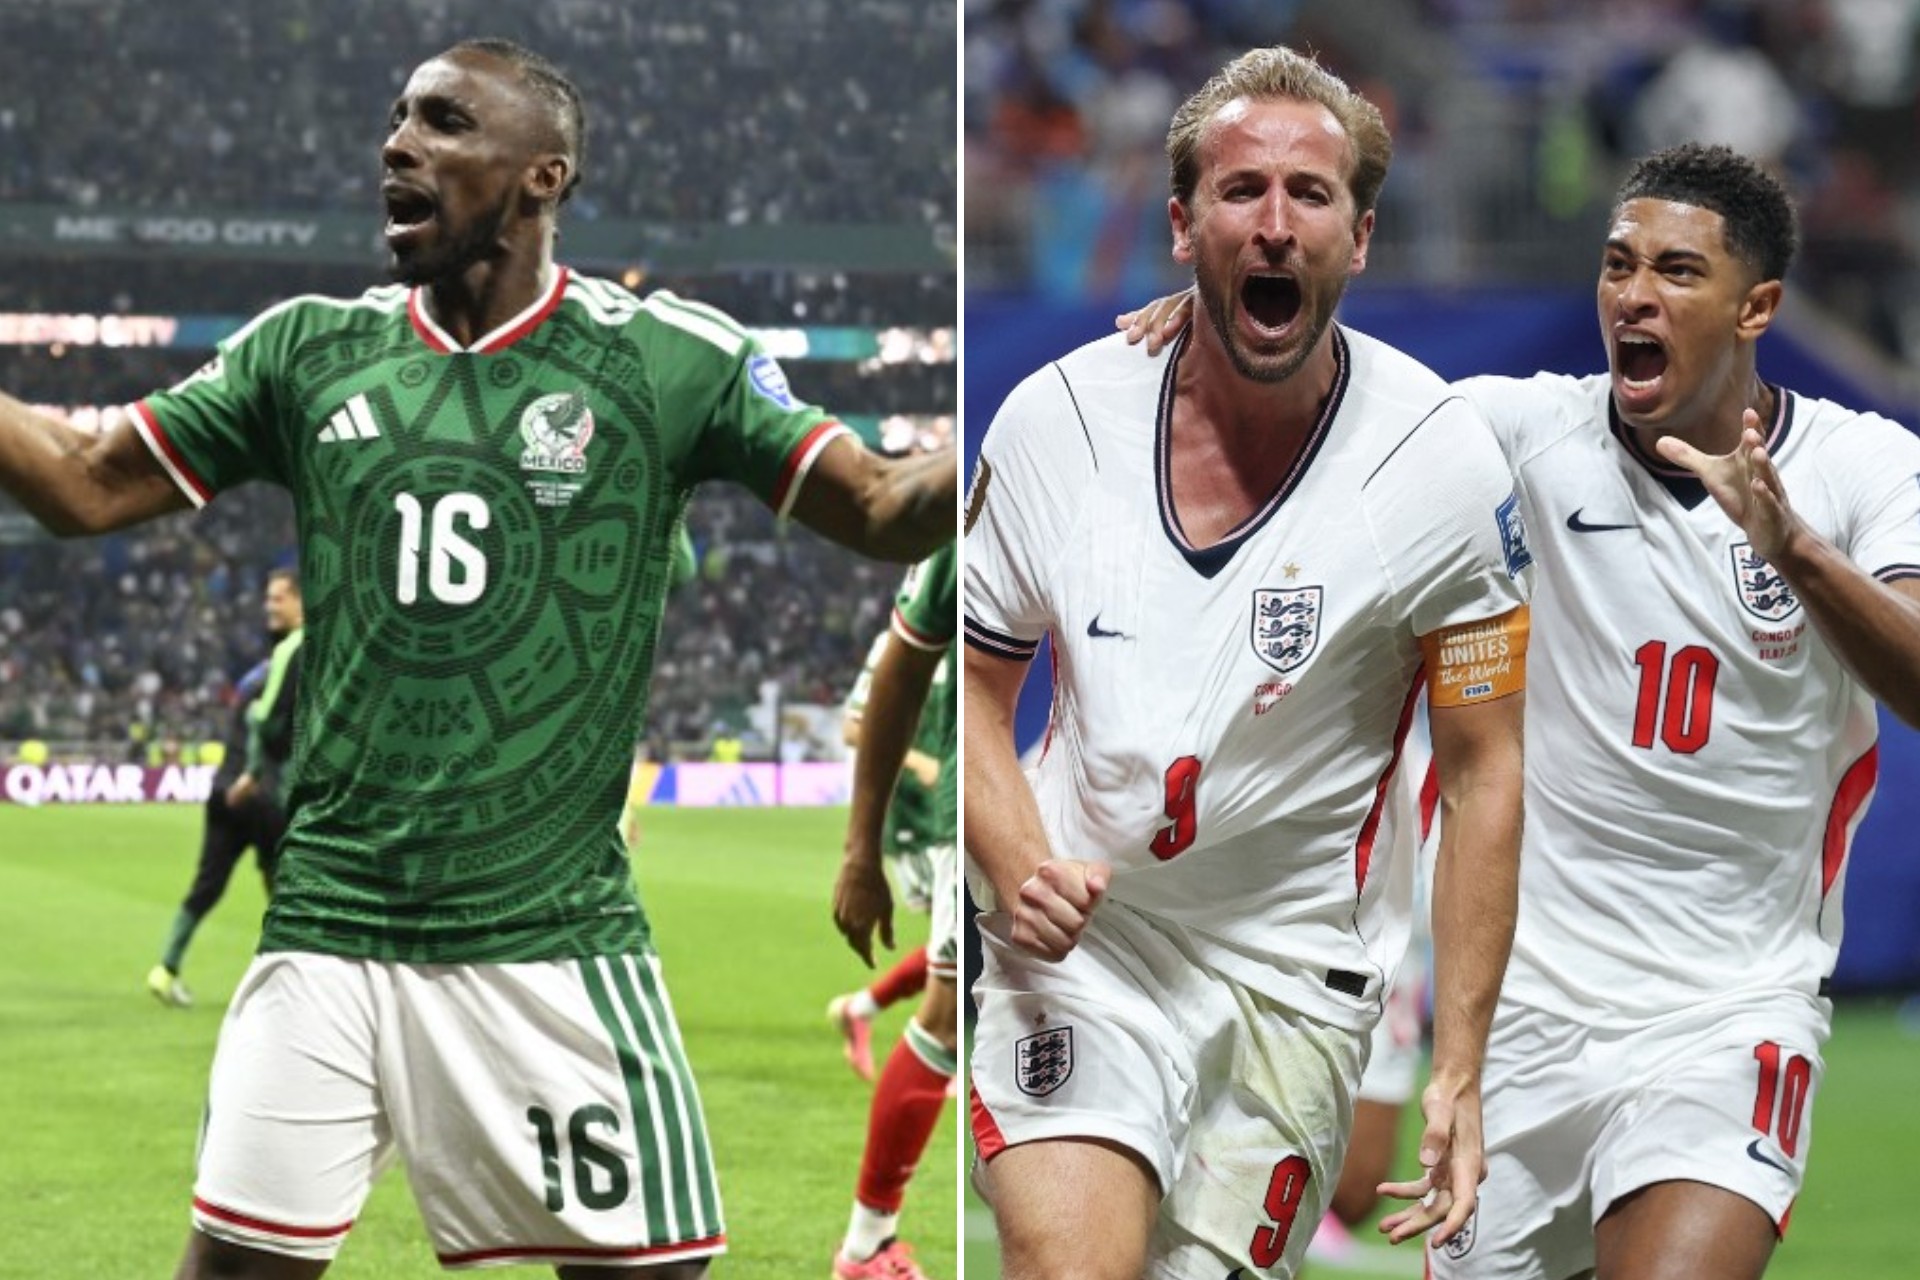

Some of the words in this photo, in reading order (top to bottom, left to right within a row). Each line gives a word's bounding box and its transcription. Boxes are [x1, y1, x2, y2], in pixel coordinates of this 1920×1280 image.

[54, 217, 217, 243] MEICO
[221, 219, 318, 246] CITY
[523, 454, 583, 470] MEXICO
[395, 491, 489, 605] 16
[1440, 635, 1510, 666] UNITES
[1752, 629, 1792, 643] CONGO
[1441, 667, 1466, 686] the
[1468, 656, 1512, 682] World
[1464, 684, 1491, 697] FIFA
[1632, 640, 1719, 754] 10
[5, 764, 145, 806] QATAR
[1148, 755, 1202, 861] 9
[1752, 1040, 1812, 1159] 10
[527, 1105, 629, 1212] 16
[1249, 1154, 1312, 1269] 9
